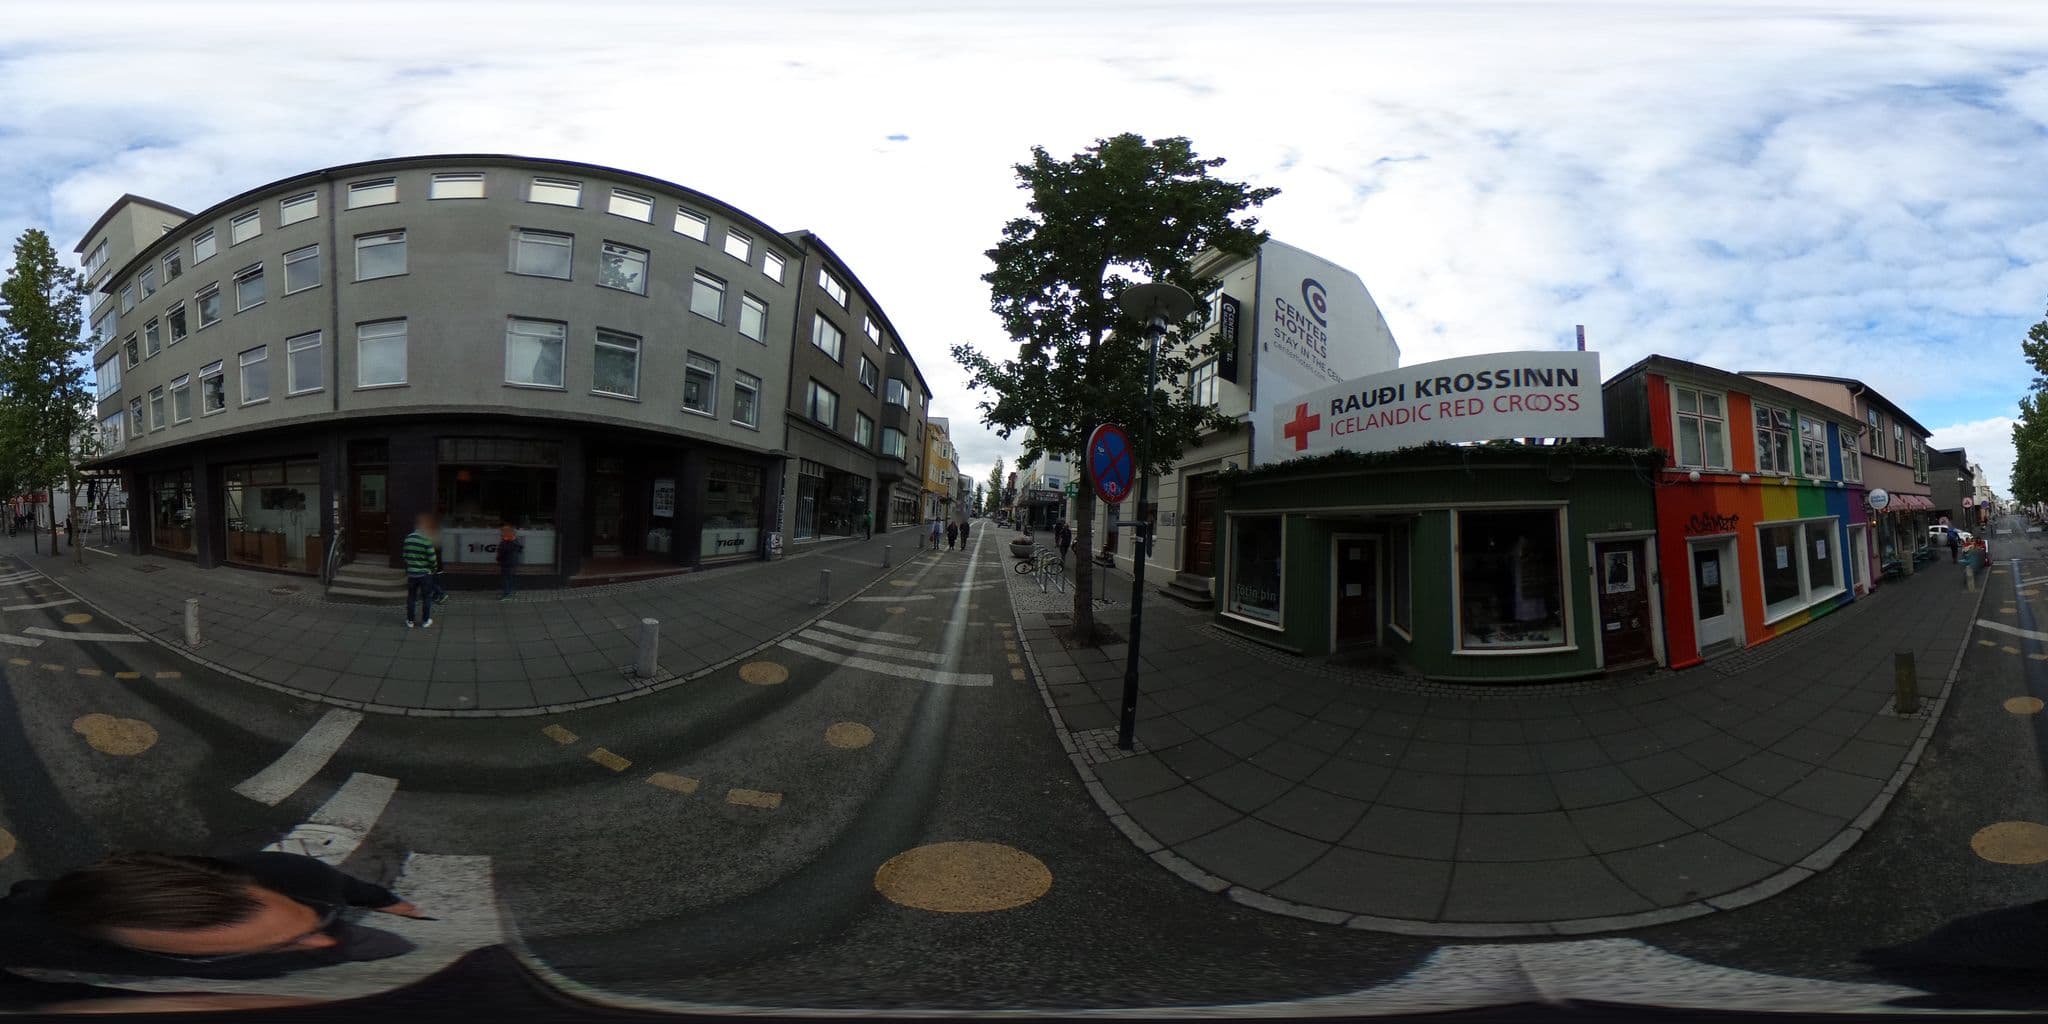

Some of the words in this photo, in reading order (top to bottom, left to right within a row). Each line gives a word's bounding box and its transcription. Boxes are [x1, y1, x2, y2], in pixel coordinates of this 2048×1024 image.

[1275, 297, 1327, 347] CENTER
[1275, 310, 1327, 359] HOTELS
[1274, 327, 1298, 350] STAY
[1300, 345, 1310, 359] IN
[1312, 354, 1326, 373] THE
[1330, 403, 1432, 437] ICELANDIC
[1439, 397, 1484, 419] RED
[1331, 383, 1405, 416] RAUÐI
[717, 538, 745, 547] TIGER
